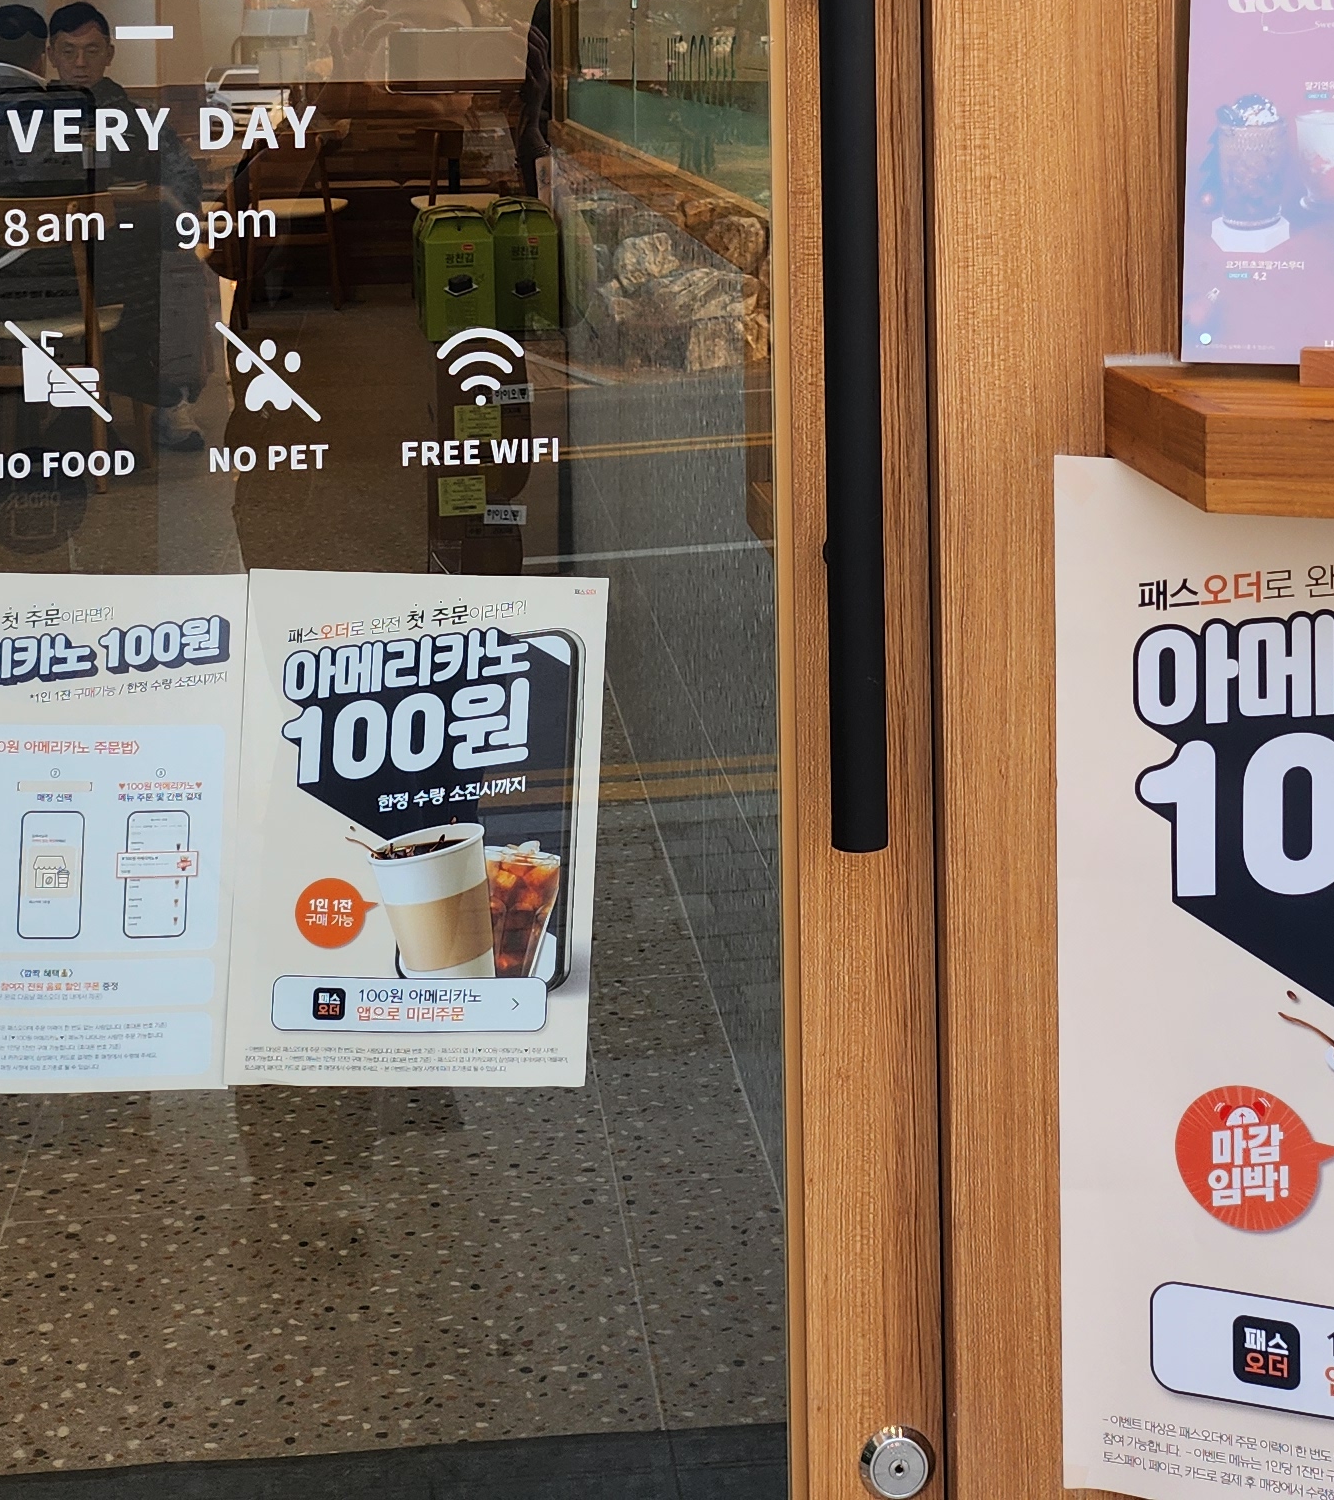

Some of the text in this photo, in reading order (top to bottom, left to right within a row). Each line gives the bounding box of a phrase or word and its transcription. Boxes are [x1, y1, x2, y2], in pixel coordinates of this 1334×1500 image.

[200, 106, 317, 150] DAY
[4, 209, 276, 250] 8am 9pm
[42, 450, 136, 478] FOOD
[209, 444, 328, 473] NO PET
[401, 437, 560, 468] FREE WIFI
[1137, 569, 1296, 610] 패스오더로
[1, 610, 19, 630] 첫
[288, 621, 365, 644] 패스오더로
[370, 617, 400, 635] 완전
[406, 609, 425, 630] 첫
[99, 616, 220, 669] 100원
[285, 628, 530, 700] 아메리카노
[283, 678, 530, 784] 100원
[378, 776, 526, 812] 한정 수량 소진시까지
[305, 914, 354, 927] 구매 가능
[309, 899, 352, 912] 1인 1잔
[1212, 1125, 1283, 1167] 마감
[1207, 1168, 1289, 1207] 임박!
[1244, 1325, 1289, 1354] 패스
[1243, 1352, 1289, 1380] 오더
[1110, 1415, 1257, 1450] 이벤트 대상은 패스오더에 주문
